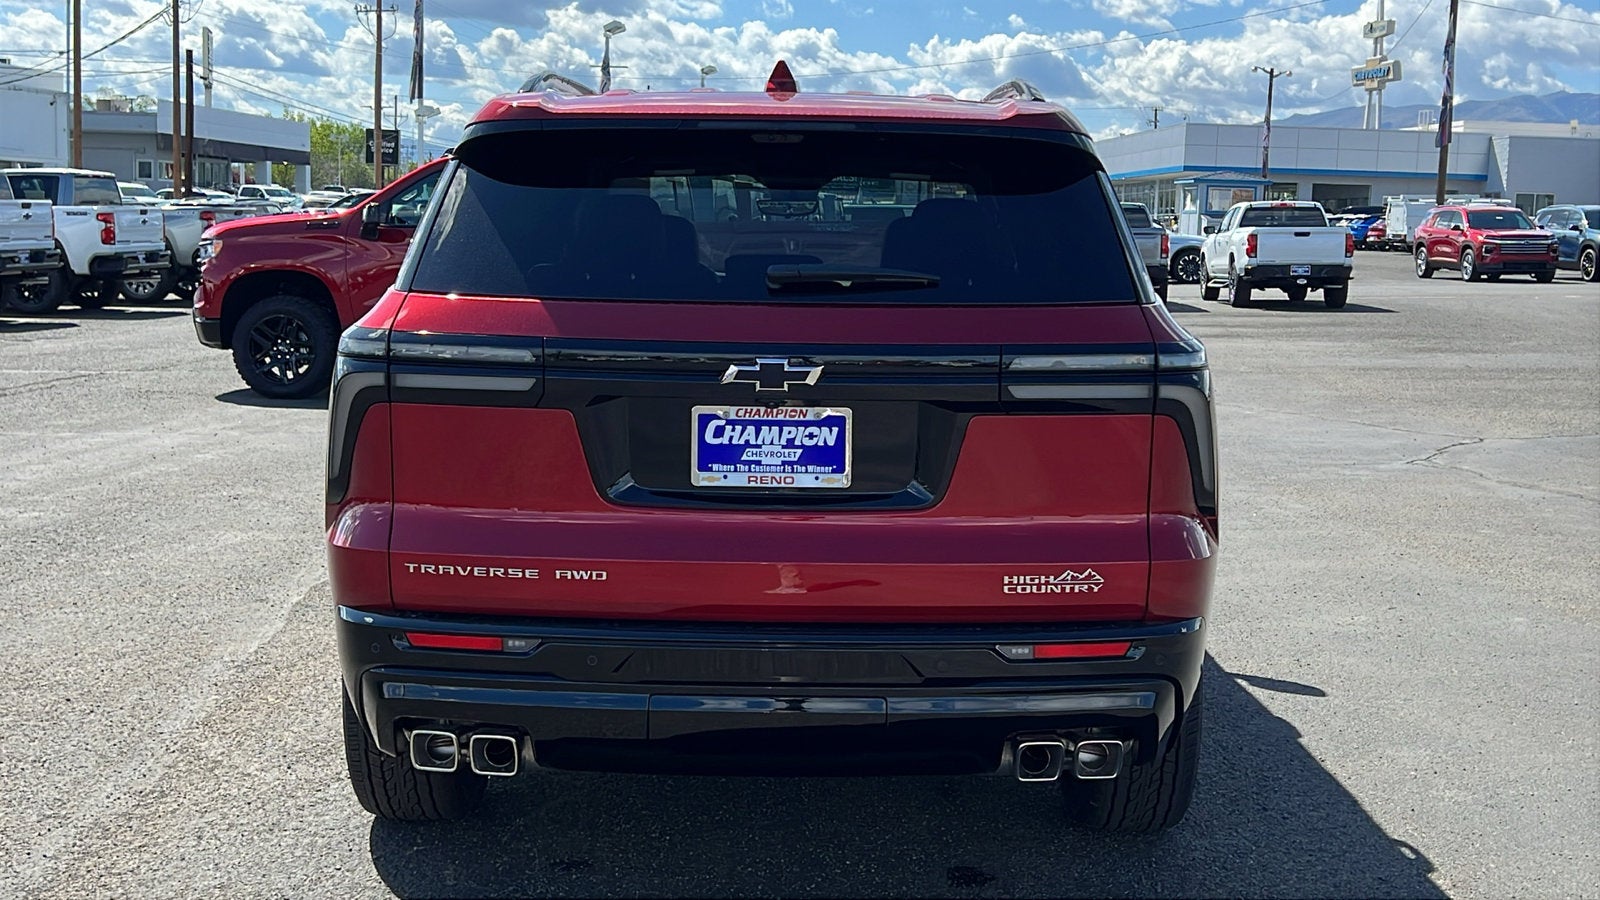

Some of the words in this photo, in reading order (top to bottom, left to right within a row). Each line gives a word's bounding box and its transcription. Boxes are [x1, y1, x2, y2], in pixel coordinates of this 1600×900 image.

[735, 408, 808, 418] CHAMPION
[704, 419, 839, 446] CHAMPION
[745, 450, 798, 459] CHEVROLET
[708, 463, 735, 472] "Where
[736, 463, 749, 472] The
[750, 464, 784, 472] Customer
[808, 465, 837, 473] Winner"
[747, 475, 795, 485] RENO
[404, 563, 540, 579] TRAVERSE
[555, 570, 607, 580] AWD
[1004, 576, 1055, 584] HIGH
[1004, 584, 1104, 594] COUNTRY
